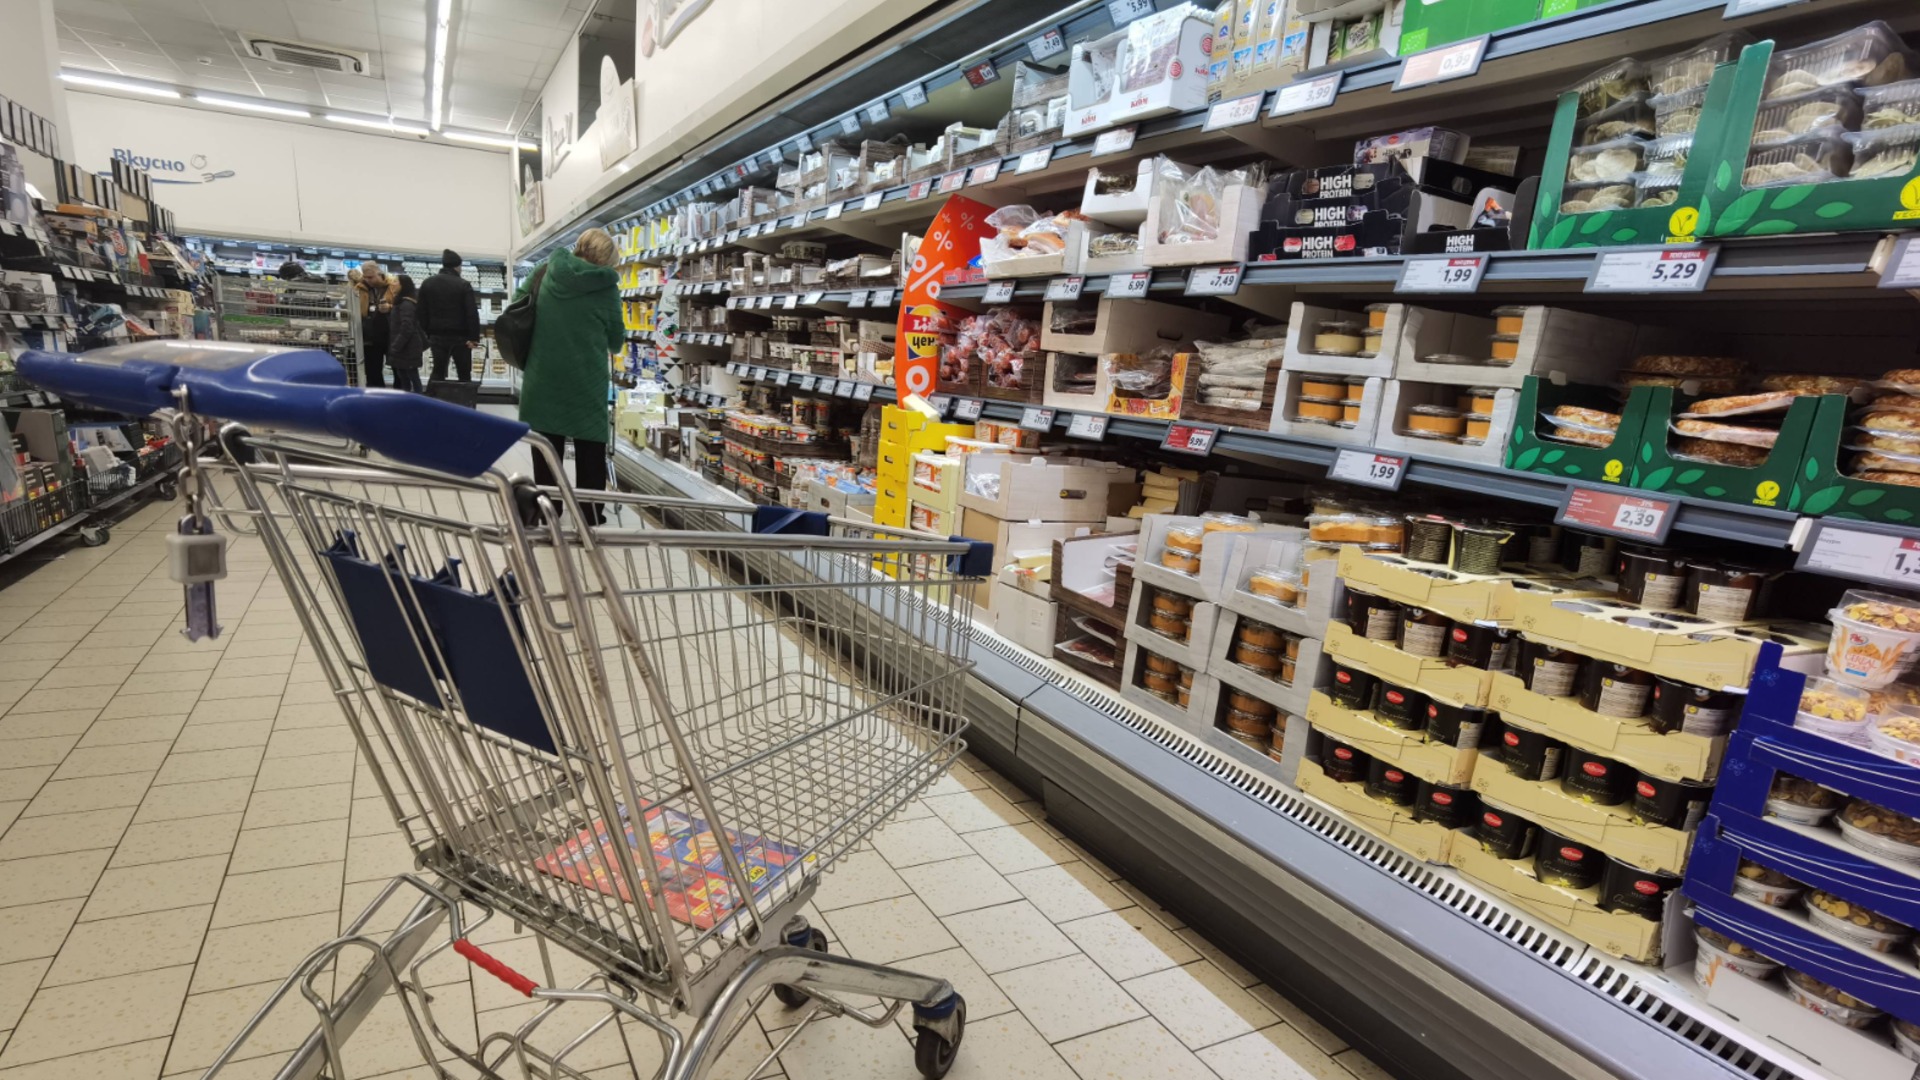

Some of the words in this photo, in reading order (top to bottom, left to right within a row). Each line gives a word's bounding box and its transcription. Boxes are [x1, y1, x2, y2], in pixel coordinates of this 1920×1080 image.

[1443, 53, 1470, 70] 0,99
[1306, 86, 1331, 102] 3,99
[1319, 173, 1352, 189] HIGH
[1319, 188, 1352, 198] PROTEIN
[1314, 205, 1346, 221] HIGH
[1302, 235, 1333, 251] HIGH
[1446, 234, 1474, 247] HIGH
[1302, 249, 1333, 259] PROTEIN
[1444, 269, 1472, 283] 1,99
[1652, 263, 1697, 281] 5,29
[1128, 280, 1145, 291] 6,99
[1214, 275, 1234, 288] 7,49
[1369, 463, 1395, 479] 1,99
[1620, 510, 1655, 527] 2,39
